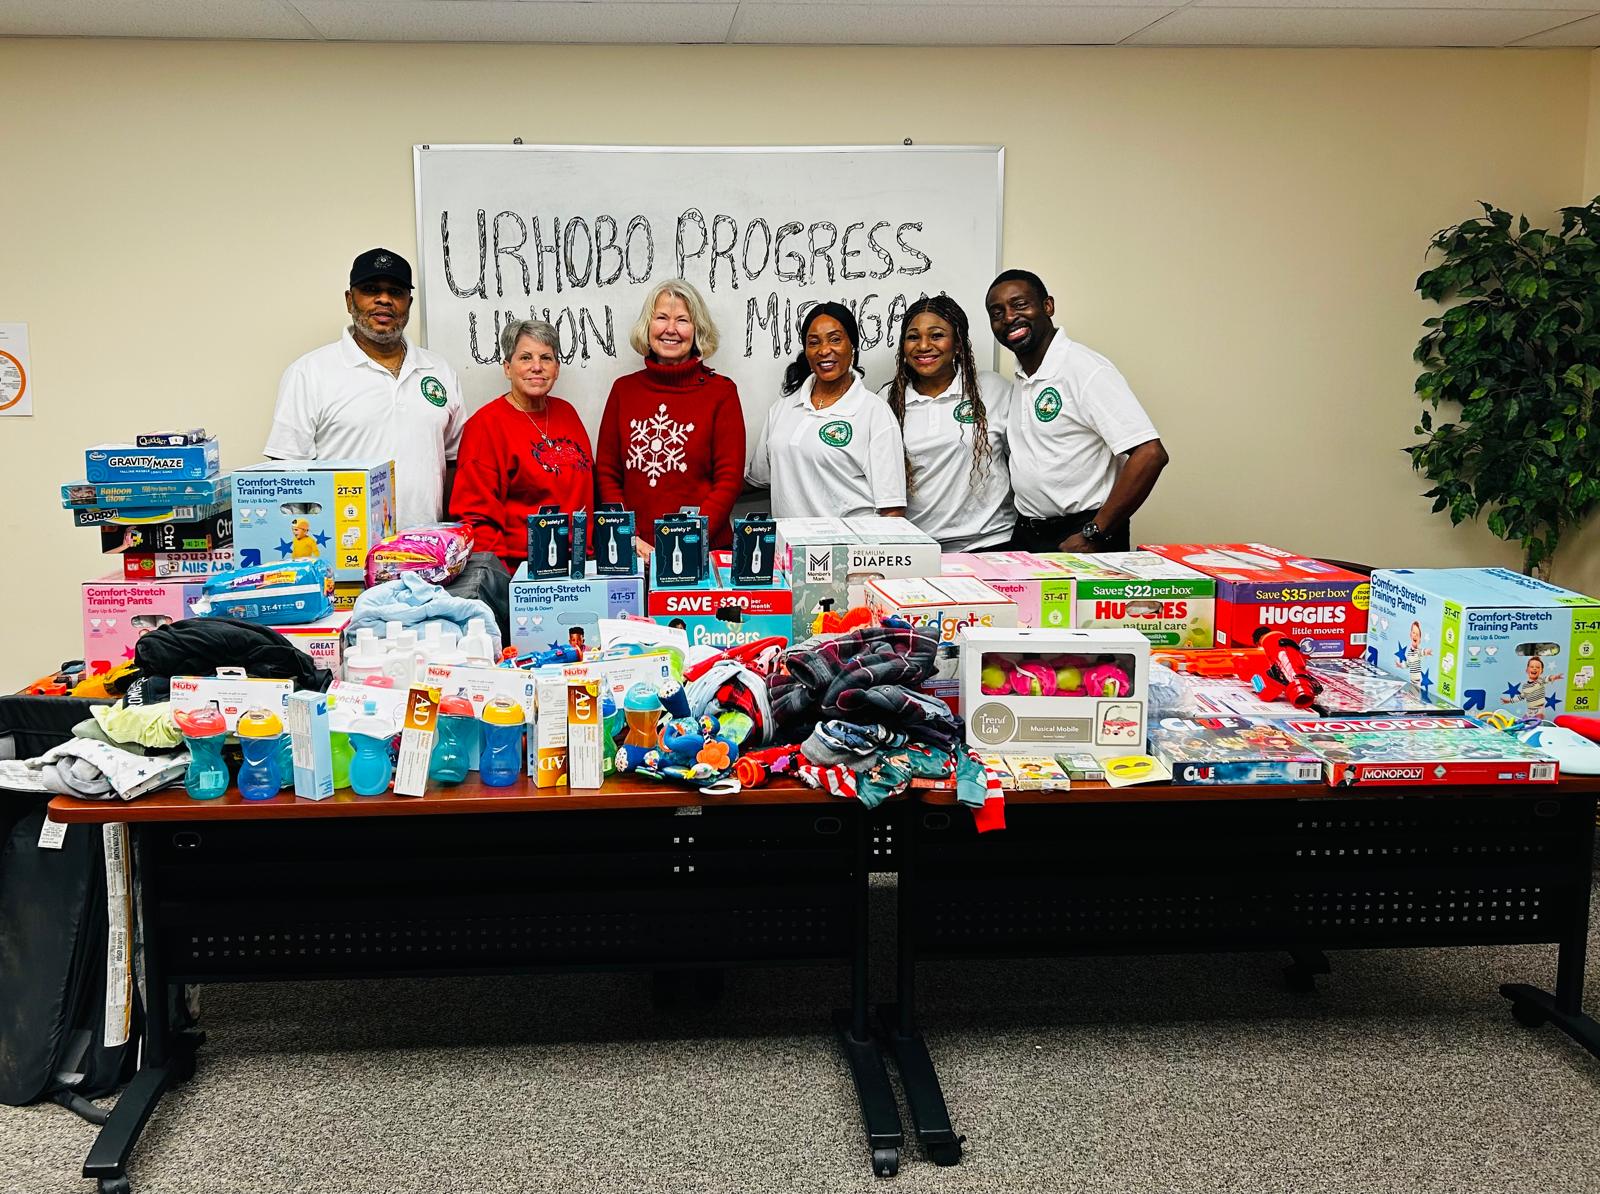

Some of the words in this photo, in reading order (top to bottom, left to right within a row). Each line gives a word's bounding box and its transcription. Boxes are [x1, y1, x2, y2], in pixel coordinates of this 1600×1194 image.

[441, 208, 654, 300] URHOBO
[676, 208, 932, 292] PROGRESS
[469, 305, 617, 368] UON
[109, 457, 153, 468] GRAVITY
[154, 459, 183, 468] MAZE
[237, 477, 316, 488] Comfort-Stretch
[100, 487, 132, 496] Balloon
[238, 487, 275, 497] Training
[276, 486, 303, 495] Pants
[337, 486, 363, 495] 2T-3T
[80, 509, 119, 523] SORRY!
[163, 524, 176, 550] Ctrl
[166, 552, 234, 561] entences
[346, 555, 358, 563] 94
[853, 556, 912, 567] DIAPERS
[182, 561, 208, 573] Silly
[211, 561, 234, 573] ery
[87, 588, 166, 597] Comfort-Stretch
[514, 584, 591, 595] Comfort-Stretch
[1093, 586, 1118, 596] Save
[1124, 585, 1151, 597] $22
[1152, 587, 1172, 596] per
[1256, 590, 1280, 600] Save
[1281, 588, 1307, 601] $35
[1308, 590, 1327, 600] per
[1371, 574, 1427, 606] Comfort-Stretch
[88, 597, 125, 606] Training
[127, 597, 153, 605] Pants
[514, 594, 552, 604] Training
[553, 594, 579, 602] Pants
[610, 592, 636, 600] 4T-5T
[1044, 593, 1068, 601] 3T-4T
[1371, 586, 1396, 608] Training
[1397, 597, 1416, 614] Pants
[667, 596, 712, 611] SAVE
[1096, 601, 1187, 619] HUES
[1259, 605, 1346, 625] HUGGIES
[1444, 607, 1460, 619] 3T-4T
[1468, 612, 1552, 622] Comfort-Stretch
[1123, 622, 1162, 631] natural
[1292, 627, 1312, 635] little
[1313, 627, 1345, 635] movers
[1468, 622, 1508, 632] Training
[1510, 621, 1538, 631] Pants
[693, 624, 760, 648] Pampers
[1576, 696, 1588, 705] 86
[981, 724, 999, 734] Lab
[1030, 725, 1055, 733] Musical
[1056, 725, 1079, 733] Mobile
[1160, 717, 1241, 731] CLUE
[1299, 718, 1467, 733] MONOPOLY
[1183, 765, 1215, 781] CLUE
[1364, 767, 1422, 780] MONOPOLY
